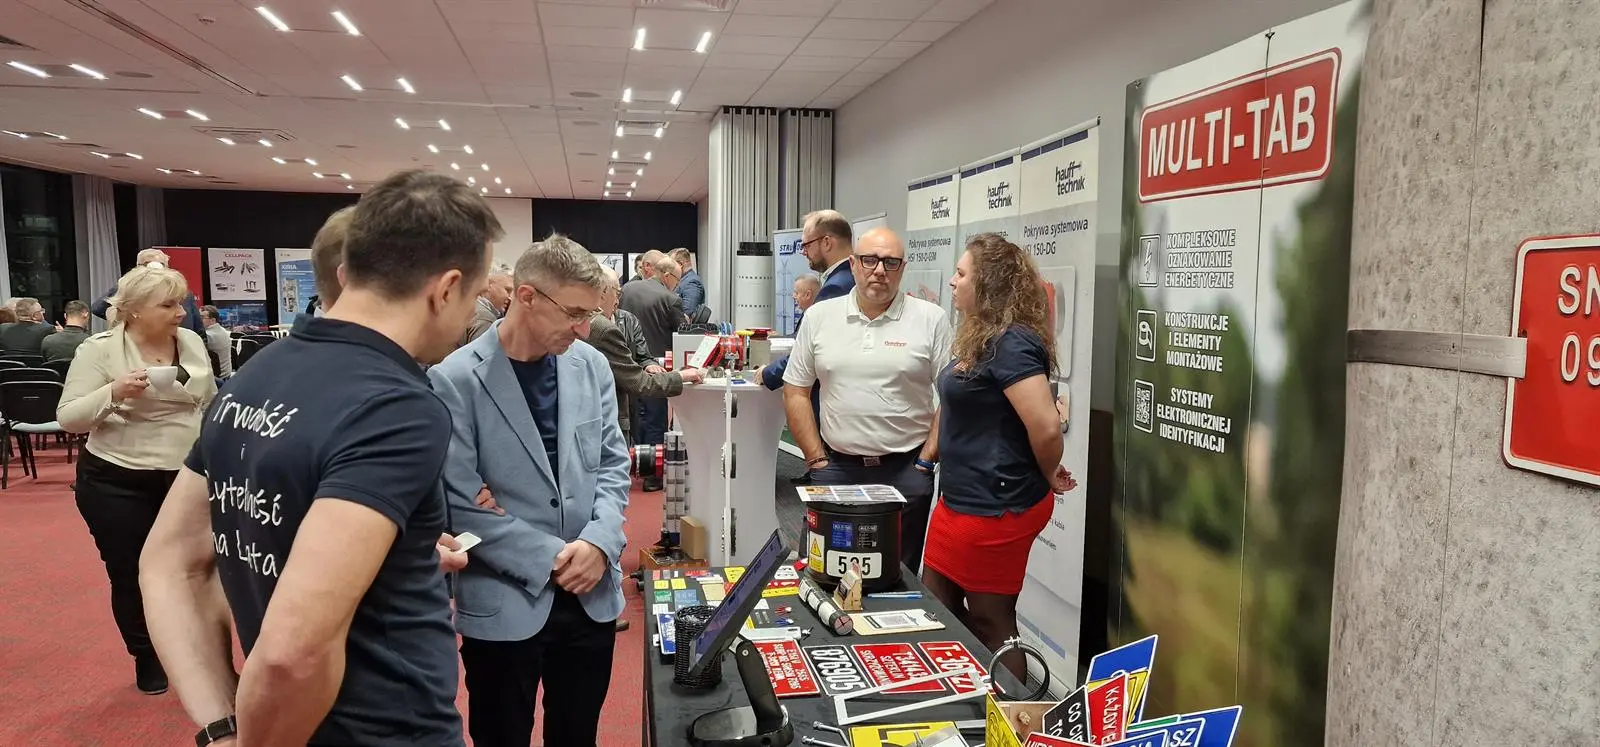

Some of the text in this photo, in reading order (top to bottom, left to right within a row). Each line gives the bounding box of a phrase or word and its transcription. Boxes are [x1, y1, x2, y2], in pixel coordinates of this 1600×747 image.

[1147, 85, 1316, 178] MULTI-TAB
[1055, 160, 1082, 183] hauff
[987, 181, 1010, 198] hauff
[1057, 174, 1086, 196] technik
[931, 197, 948, 211] hauff
[988, 193, 1013, 210] technik
[931, 207, 951, 220] technik
[1023, 223, 1049, 239] Pokrywa
[1050, 218, 1089, 238] systemowa
[1166, 229, 1236, 249] KOMPLEKSOWE
[908, 237, 951, 251] Pokrywa systemowa
[1033, 241, 1056, 256] 150-DG
[1167, 250, 1232, 268] OZNAKOWANIE
[1165, 271, 1234, 288] ENERGETYCZNE
[1165, 312, 1229, 332] KONSTRUKCJE
[1168, 331, 1222, 352] I ELEMENTY
[1166, 350, 1223, 372] MONTAŻOWE
[1170, 387, 1214, 410] SYSTEMY
[1156, 403, 1232, 435] ELEKTRONICZNEJ
[1159, 425, 1226, 453] IDENTYFIKACJI
[240, 443, 246, 460] i
[811, 648, 867, 691] 876905
[1068, 702, 1081, 723] CO
[1102, 686, 1121, 730] KAŻDY
